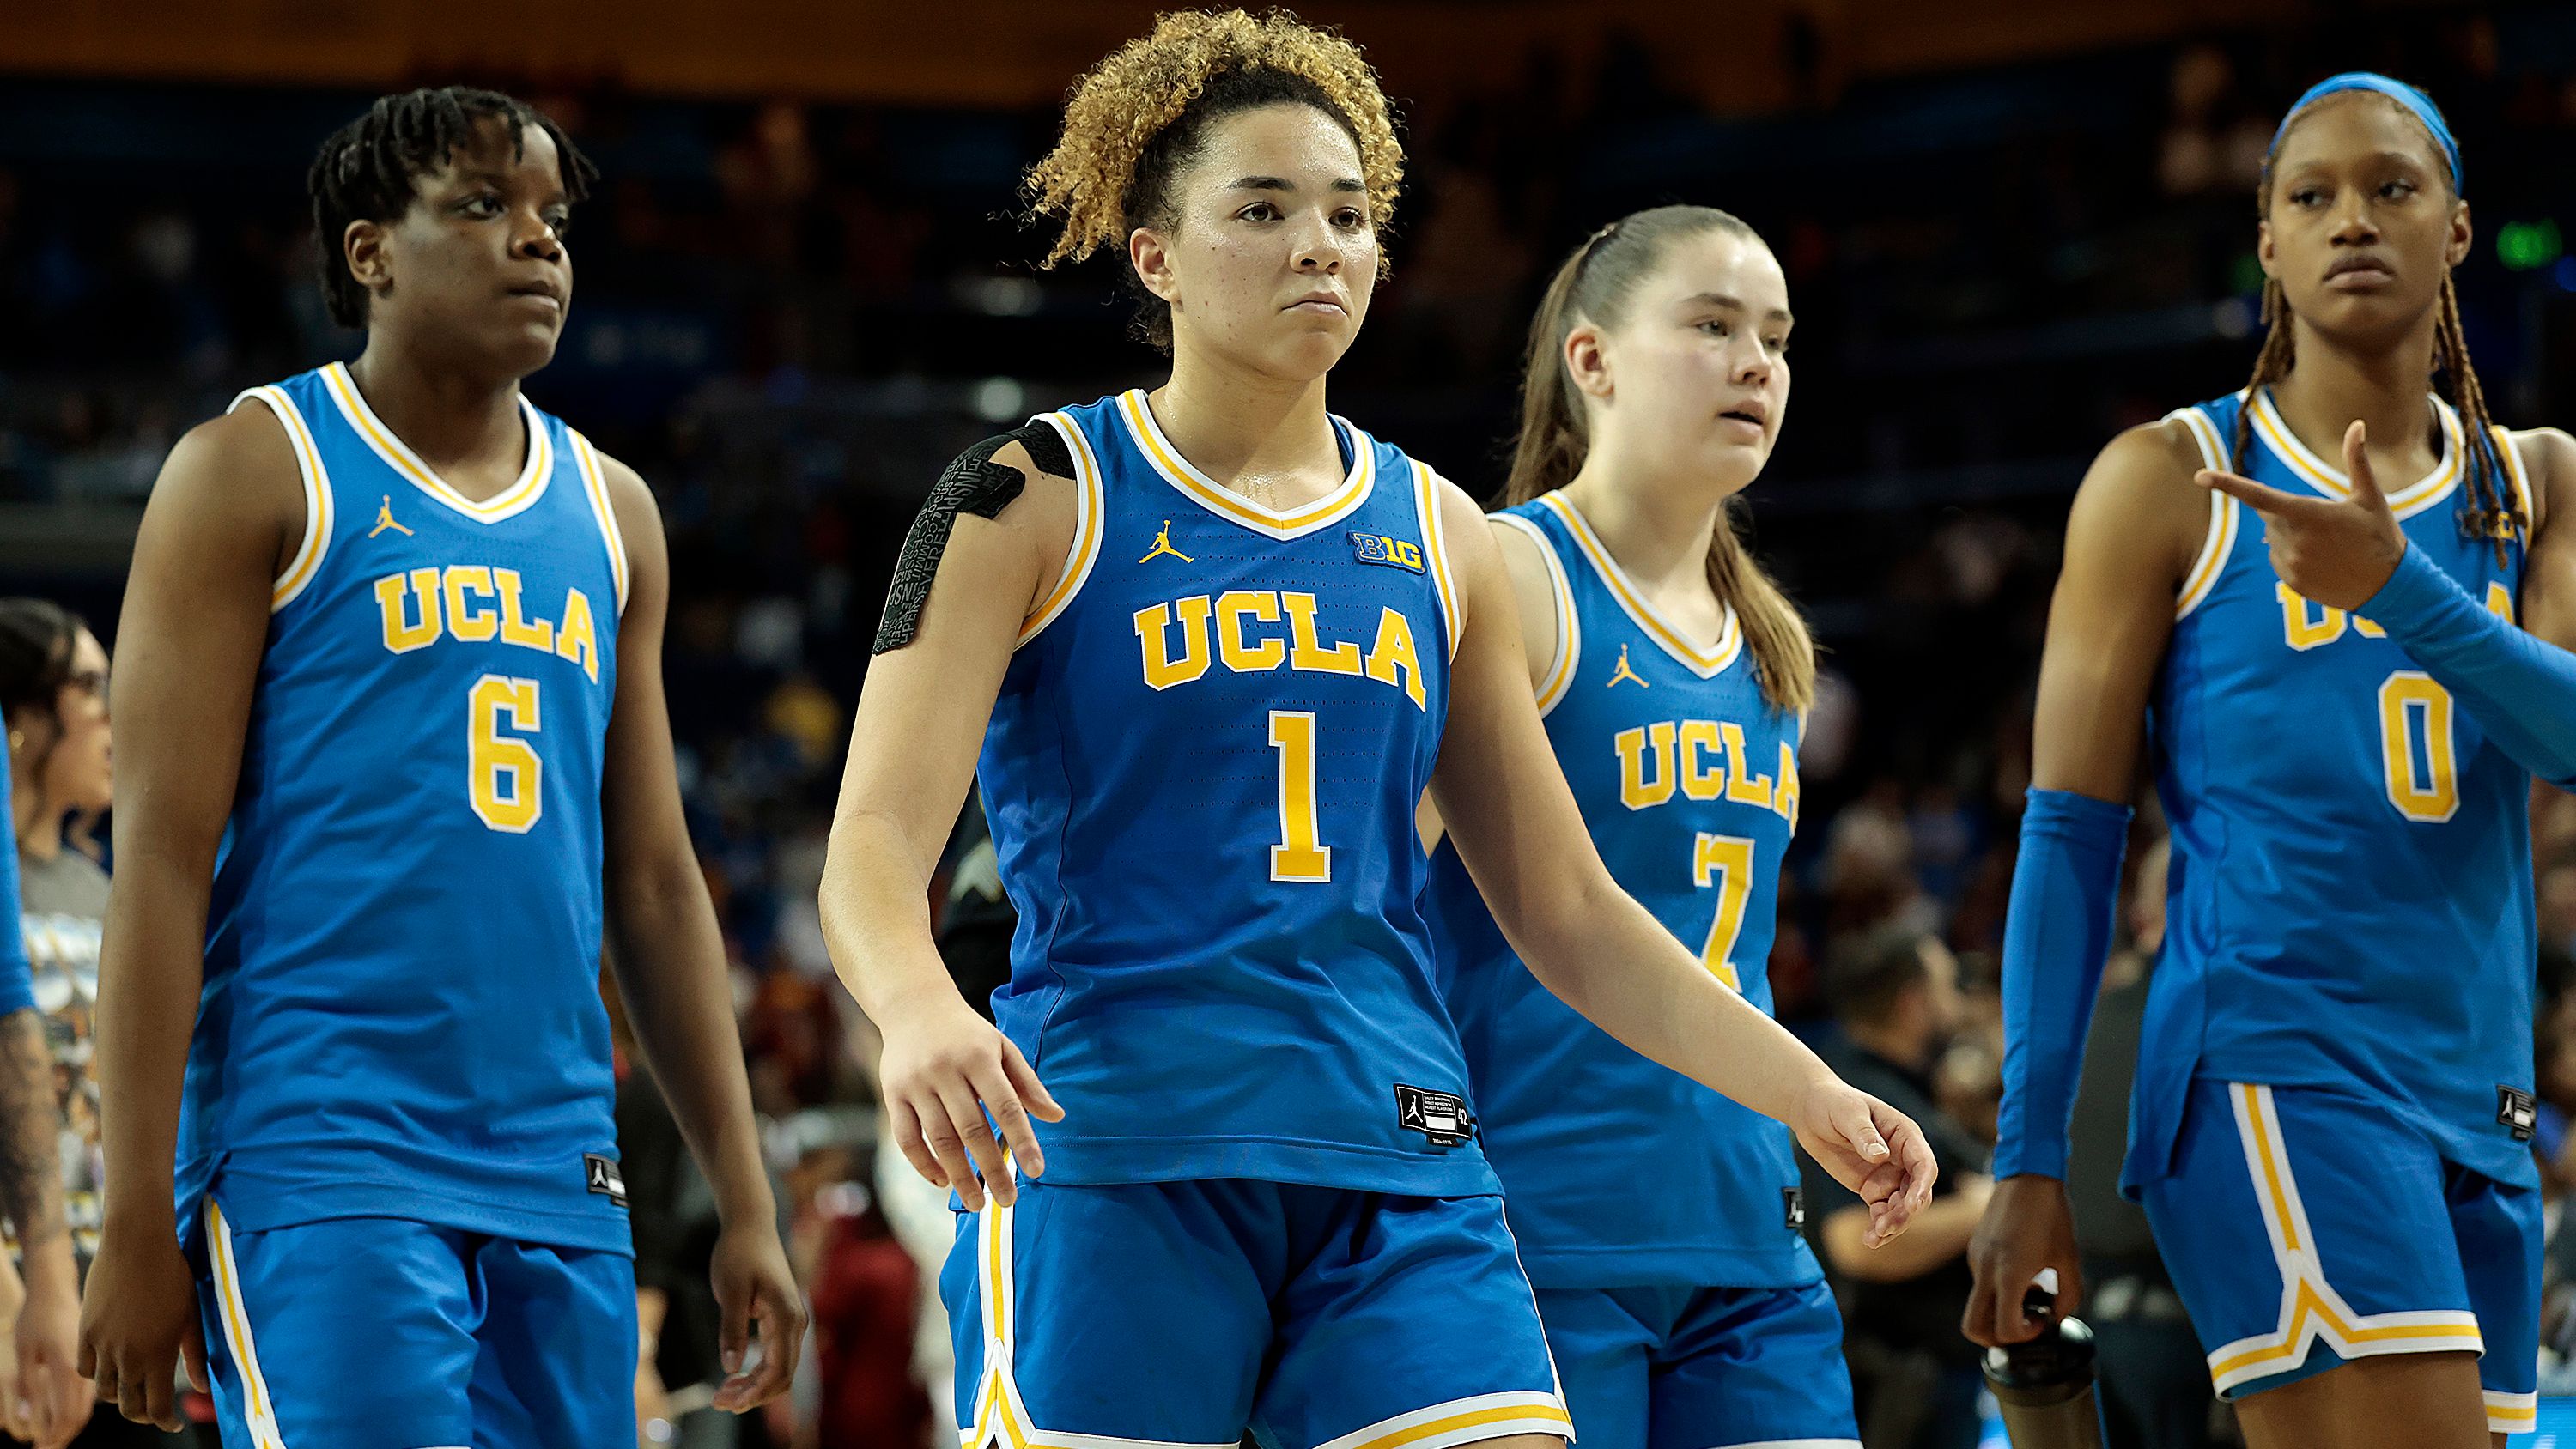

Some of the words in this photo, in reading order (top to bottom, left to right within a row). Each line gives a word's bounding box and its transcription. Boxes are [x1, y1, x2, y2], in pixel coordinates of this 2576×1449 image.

[911, 522, 939, 581] COMMIT
[374, 564, 600, 686] UCLA
[1133, 590, 1427, 713] UCLA
[467, 673, 544, 835] 6
[1267, 709, 1331, 883] 1
[1614, 718, 1801, 839] UCLA
[2377, 670, 2461, 824] 0
[1692, 830, 1755, 994] 7
